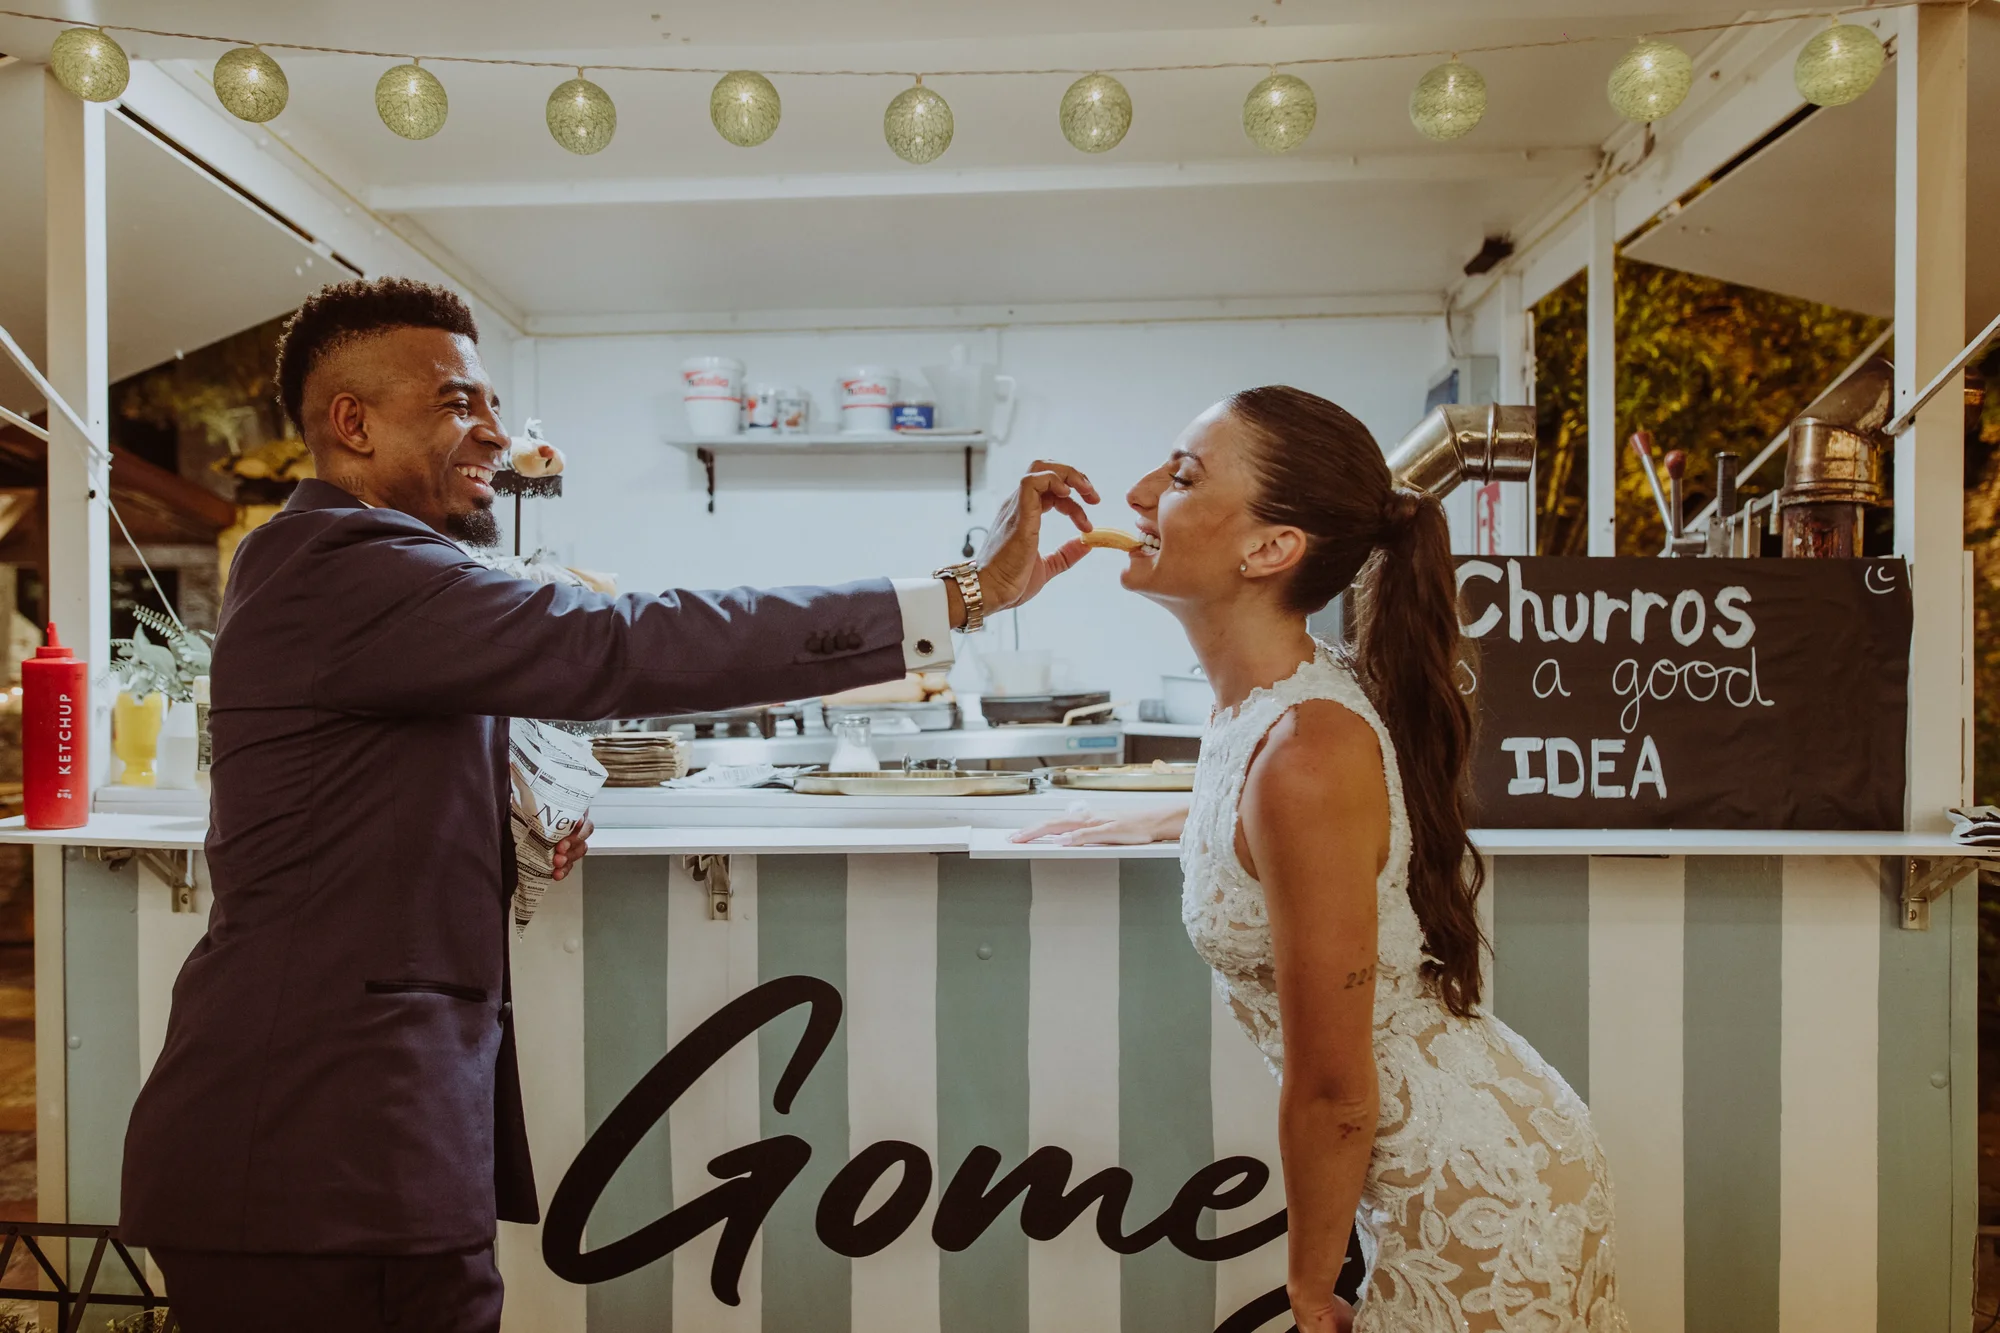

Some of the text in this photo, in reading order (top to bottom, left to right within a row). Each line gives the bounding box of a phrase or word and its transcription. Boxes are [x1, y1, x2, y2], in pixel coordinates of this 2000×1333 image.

[1455, 558, 1757, 649] Churros
[1456, 647, 1775, 733] s a good
[58, 693, 72, 775] KETCHUP
[1501, 736, 1668, 800] IDEA
[542, 974, 1364, 1307] Gome
